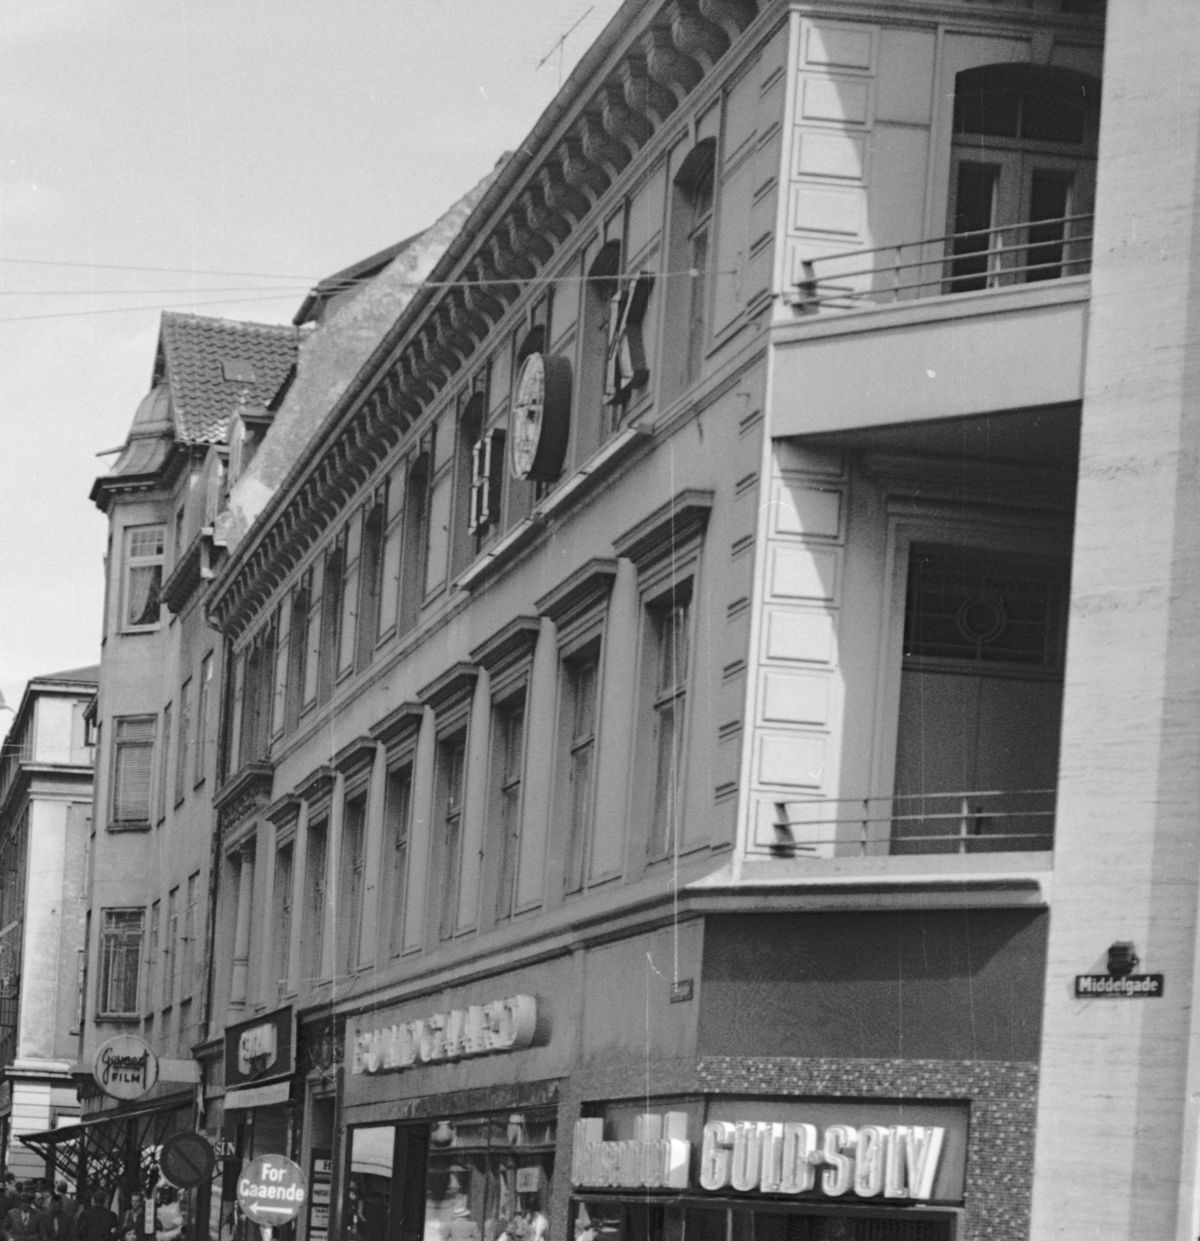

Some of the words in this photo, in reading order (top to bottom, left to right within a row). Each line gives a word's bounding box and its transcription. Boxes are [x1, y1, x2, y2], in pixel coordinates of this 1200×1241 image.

[1079, 976, 1158, 995] Middelgade
[111, 1072, 140, 1083] FILM
[700, 1120, 818, 1195] GULD
[821, 1123, 945, 1200] SØLV
[261, 1163, 287, 1181] For
[239, 1179, 305, 1202] Gaaende
